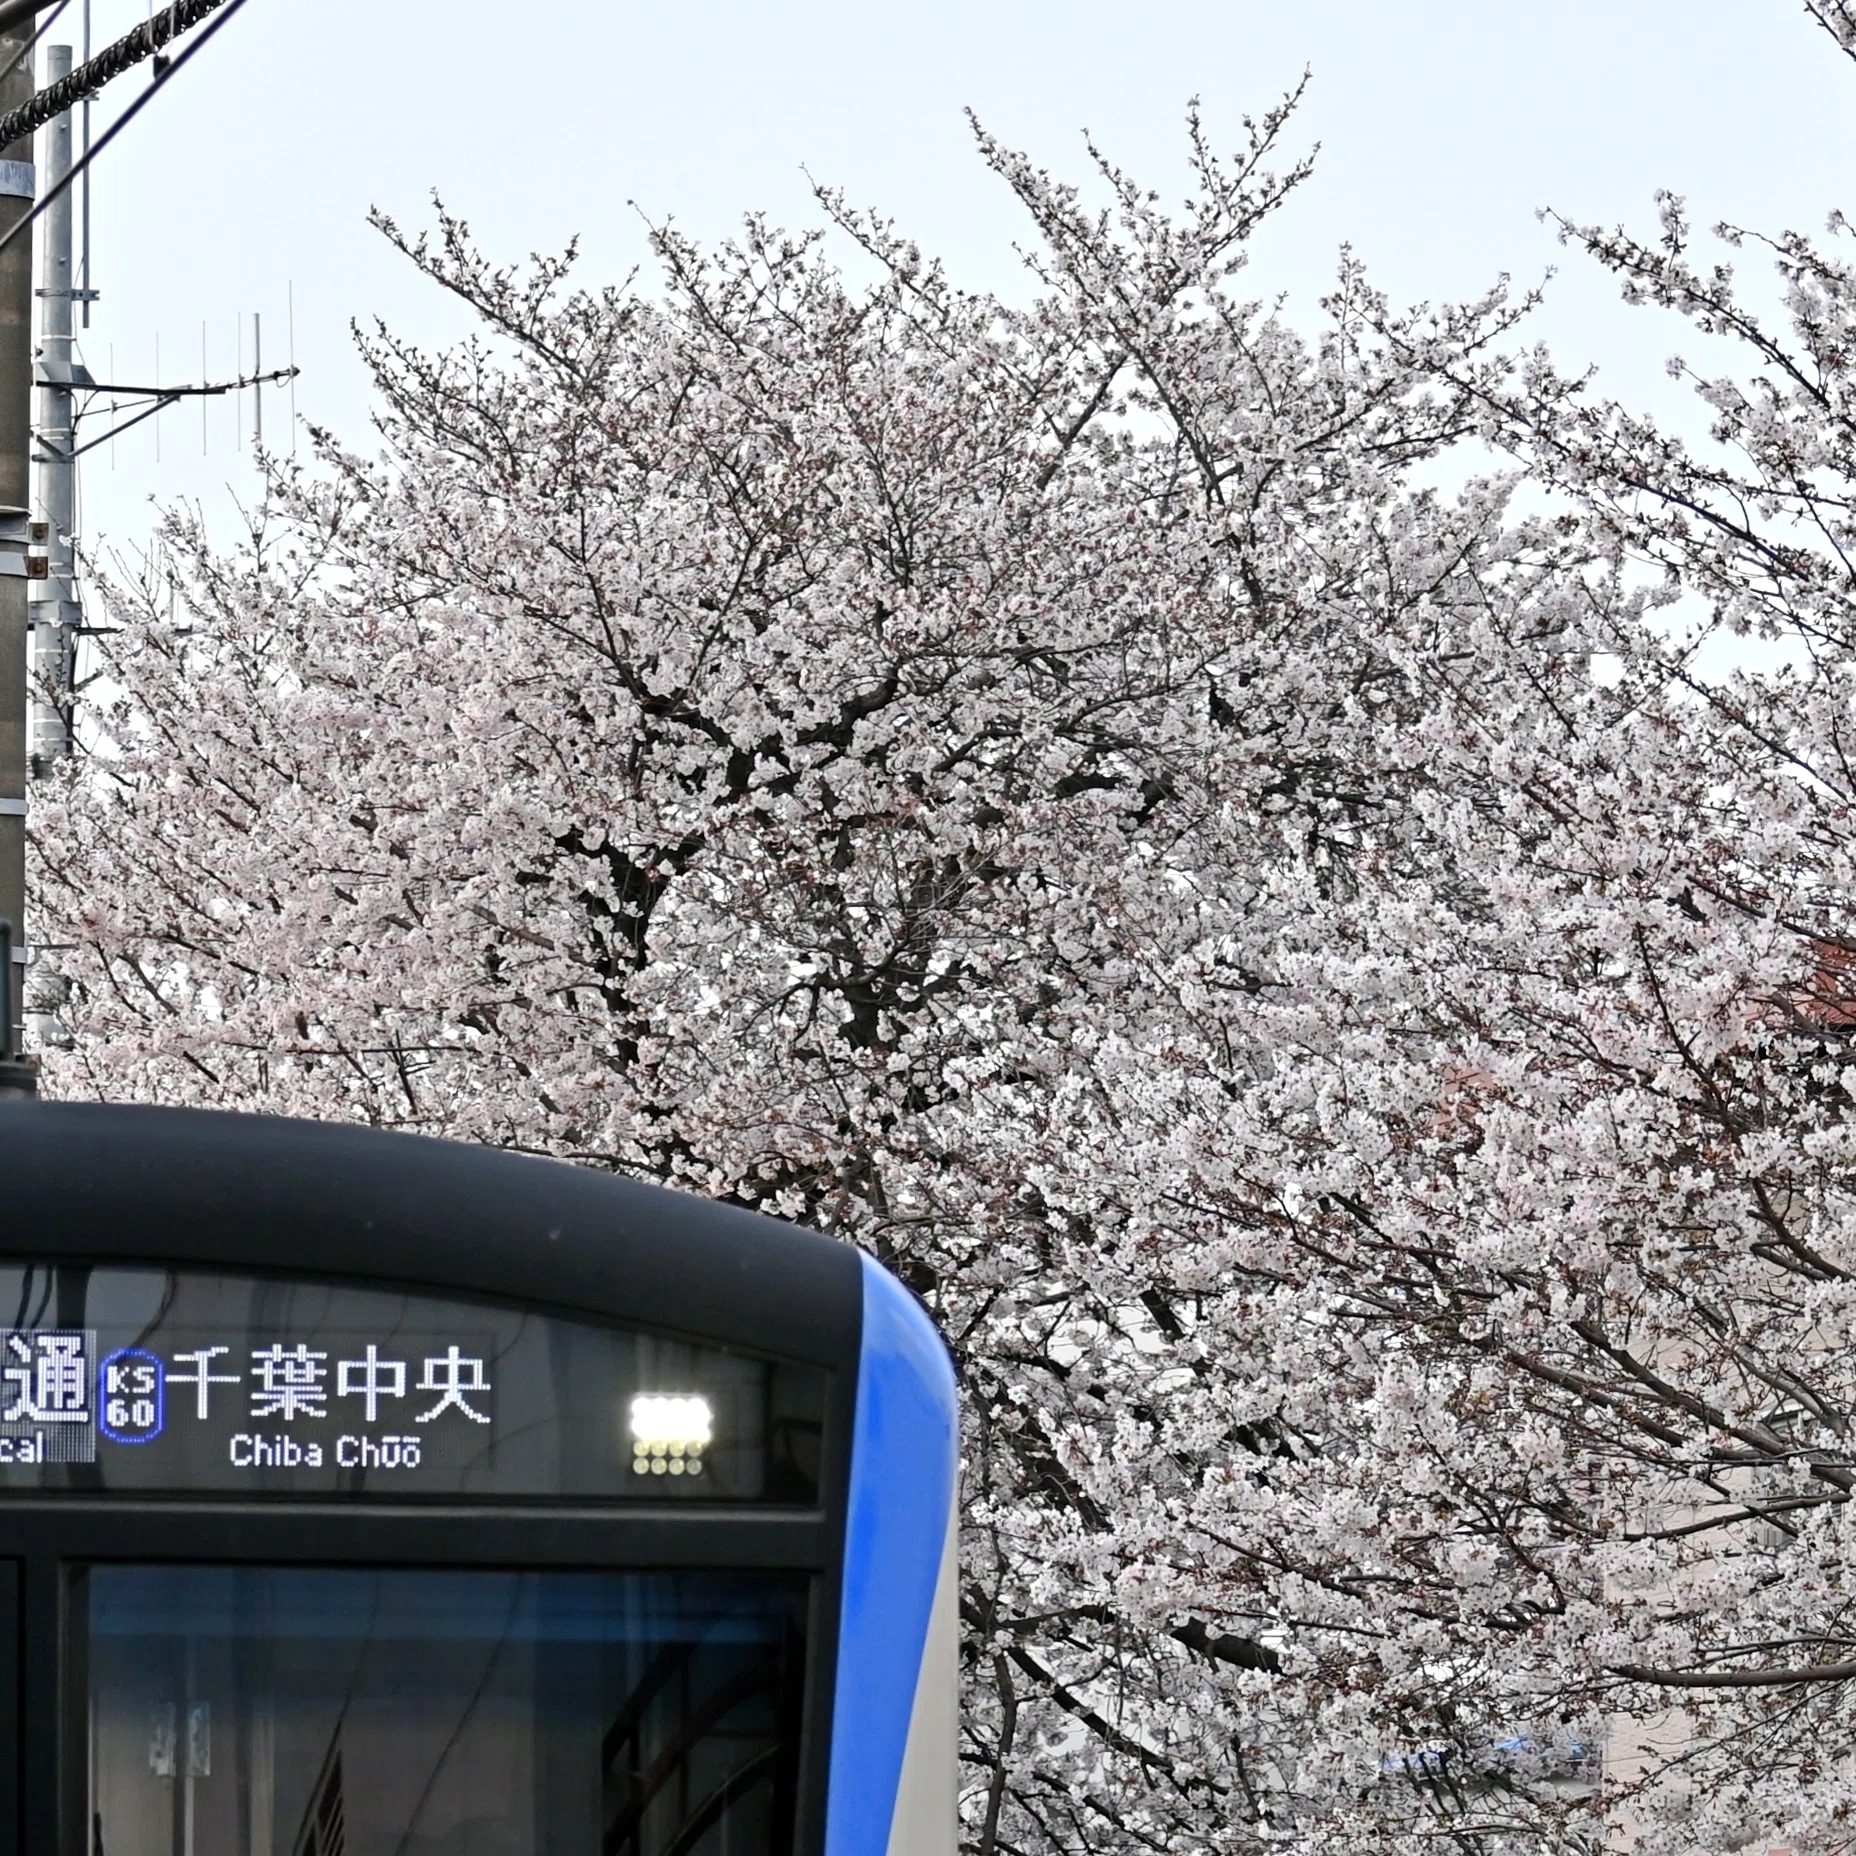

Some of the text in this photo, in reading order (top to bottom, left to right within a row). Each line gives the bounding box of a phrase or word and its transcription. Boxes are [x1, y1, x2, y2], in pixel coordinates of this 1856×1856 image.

[107, 1365, 156, 1393] KS
[165, 1344, 491, 1424] 千葉中央
[106, 1399, 155, 1427] 60
[229, 1433, 323, 1467] Chiba
